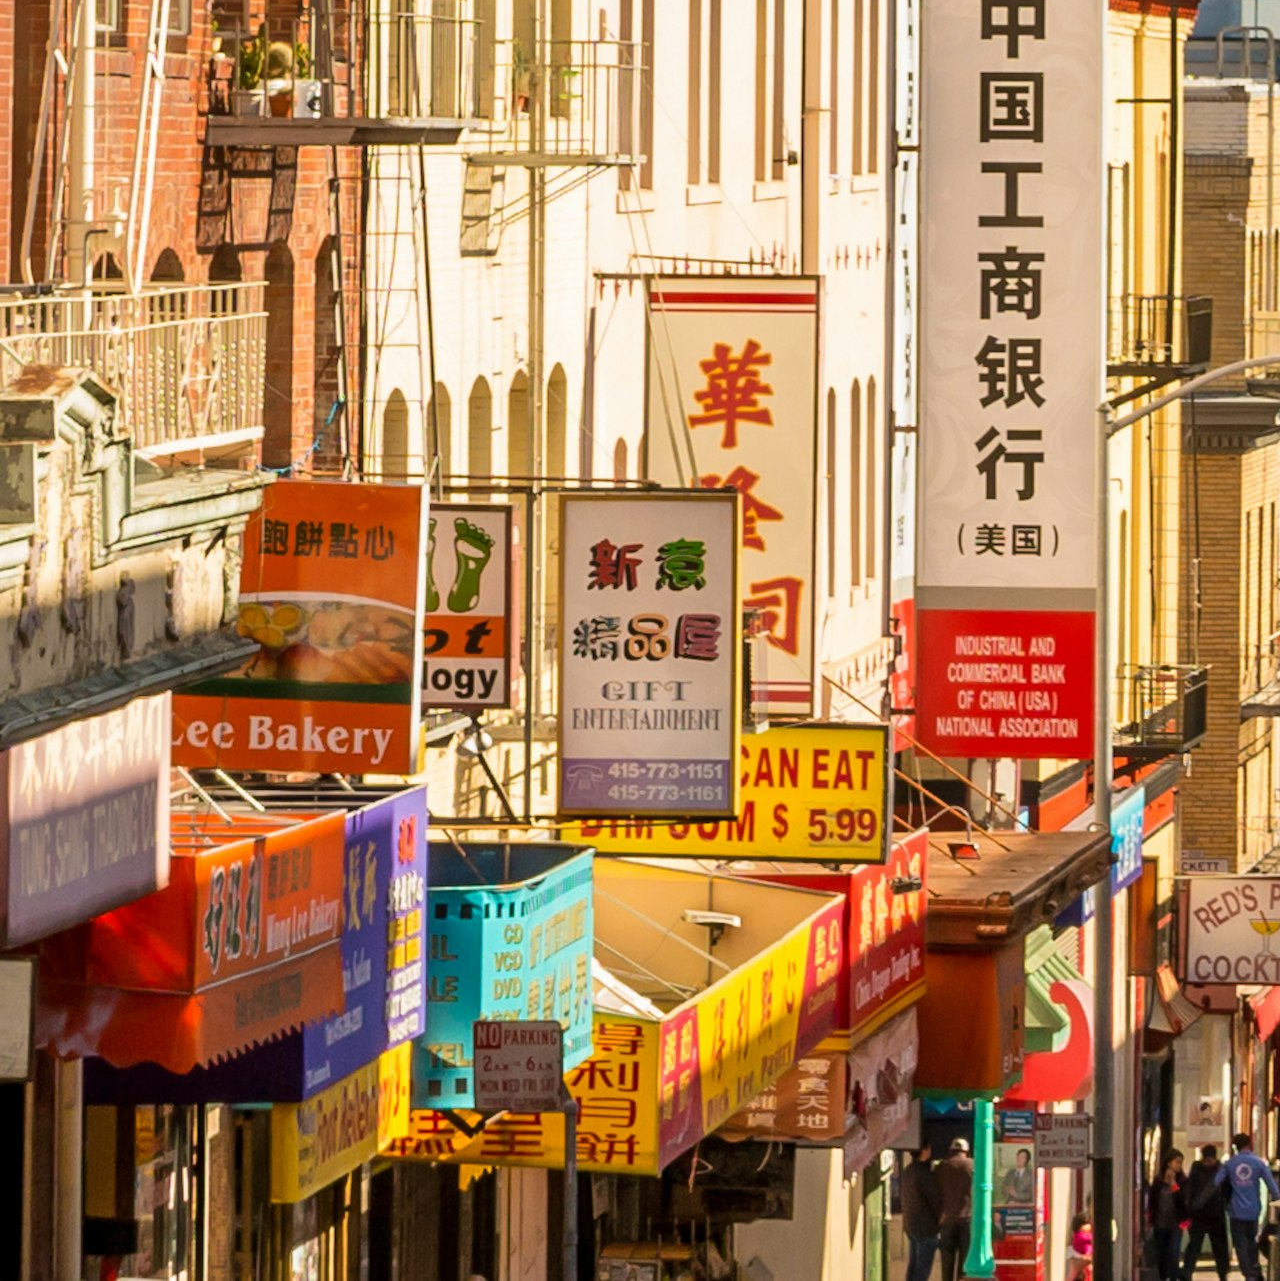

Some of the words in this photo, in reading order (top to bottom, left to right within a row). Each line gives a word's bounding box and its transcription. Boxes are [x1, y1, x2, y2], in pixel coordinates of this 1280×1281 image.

[573, 612, 722, 662] 精品屋
[956, 636, 1026, 657] INDUSTRIAL
[1028, 637, 1056, 657] AND
[947, 663, 1028, 685] COMMERCIAL
[1031, 664, 1066, 685] BANK
[601, 680, 693, 702] GIFT
[957, 690, 974, 710] OF
[572, 708, 723, 732] ENTERTAINMENT
[936, 718, 995, 738] NATIONAL
[999, 718, 1079, 738] ASSOCIATION
[249, 716, 394, 765] Bakery
[608, 761, 723, 781] 415-773-1151
[740, 746, 799, 789] CAN
[812, 749, 875, 790] EAT
[608, 785, 723, 802] 415-773-1161
[773, 801, 789, 843] $
[808, 808, 877, 843] 5.99
[1182, 861, 1220, 872] CKETT
[1193, 883, 1258, 935] RED'S
[493, 952, 522, 973] VCD
[493, 979, 522, 1001] DVD
[476, 1023, 500, 1047] NO
[503, 1024, 559, 1046] PARKING
[482, 1055, 493, 1072] 2
[525, 1056, 536, 1072] 6
